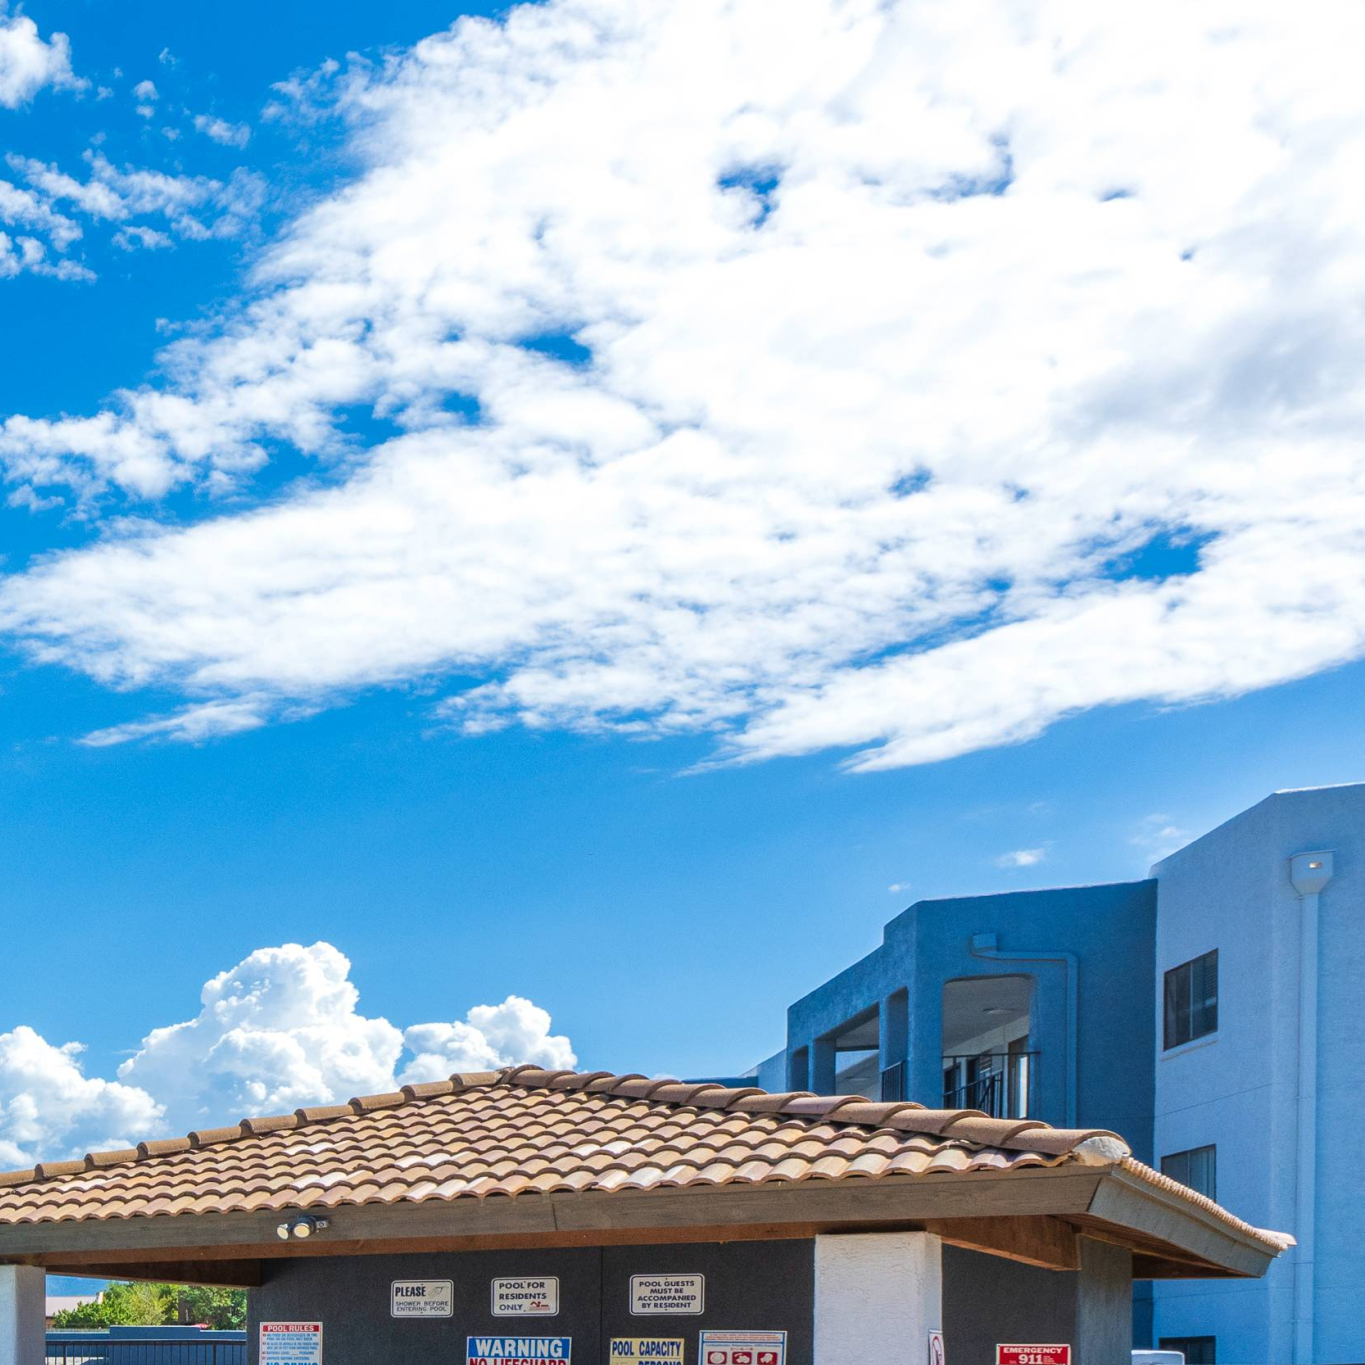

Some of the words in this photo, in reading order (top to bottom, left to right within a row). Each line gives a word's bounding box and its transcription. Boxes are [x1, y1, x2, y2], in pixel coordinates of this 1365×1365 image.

[395, 1286, 426, 1297] PLEASE
[475, 1339, 563, 1357] WARNING
[612, 1340, 634, 1356] POOL
[639, 1340, 682, 1356] CAPACITY
[1018, 1354, 1043, 1365] 911
